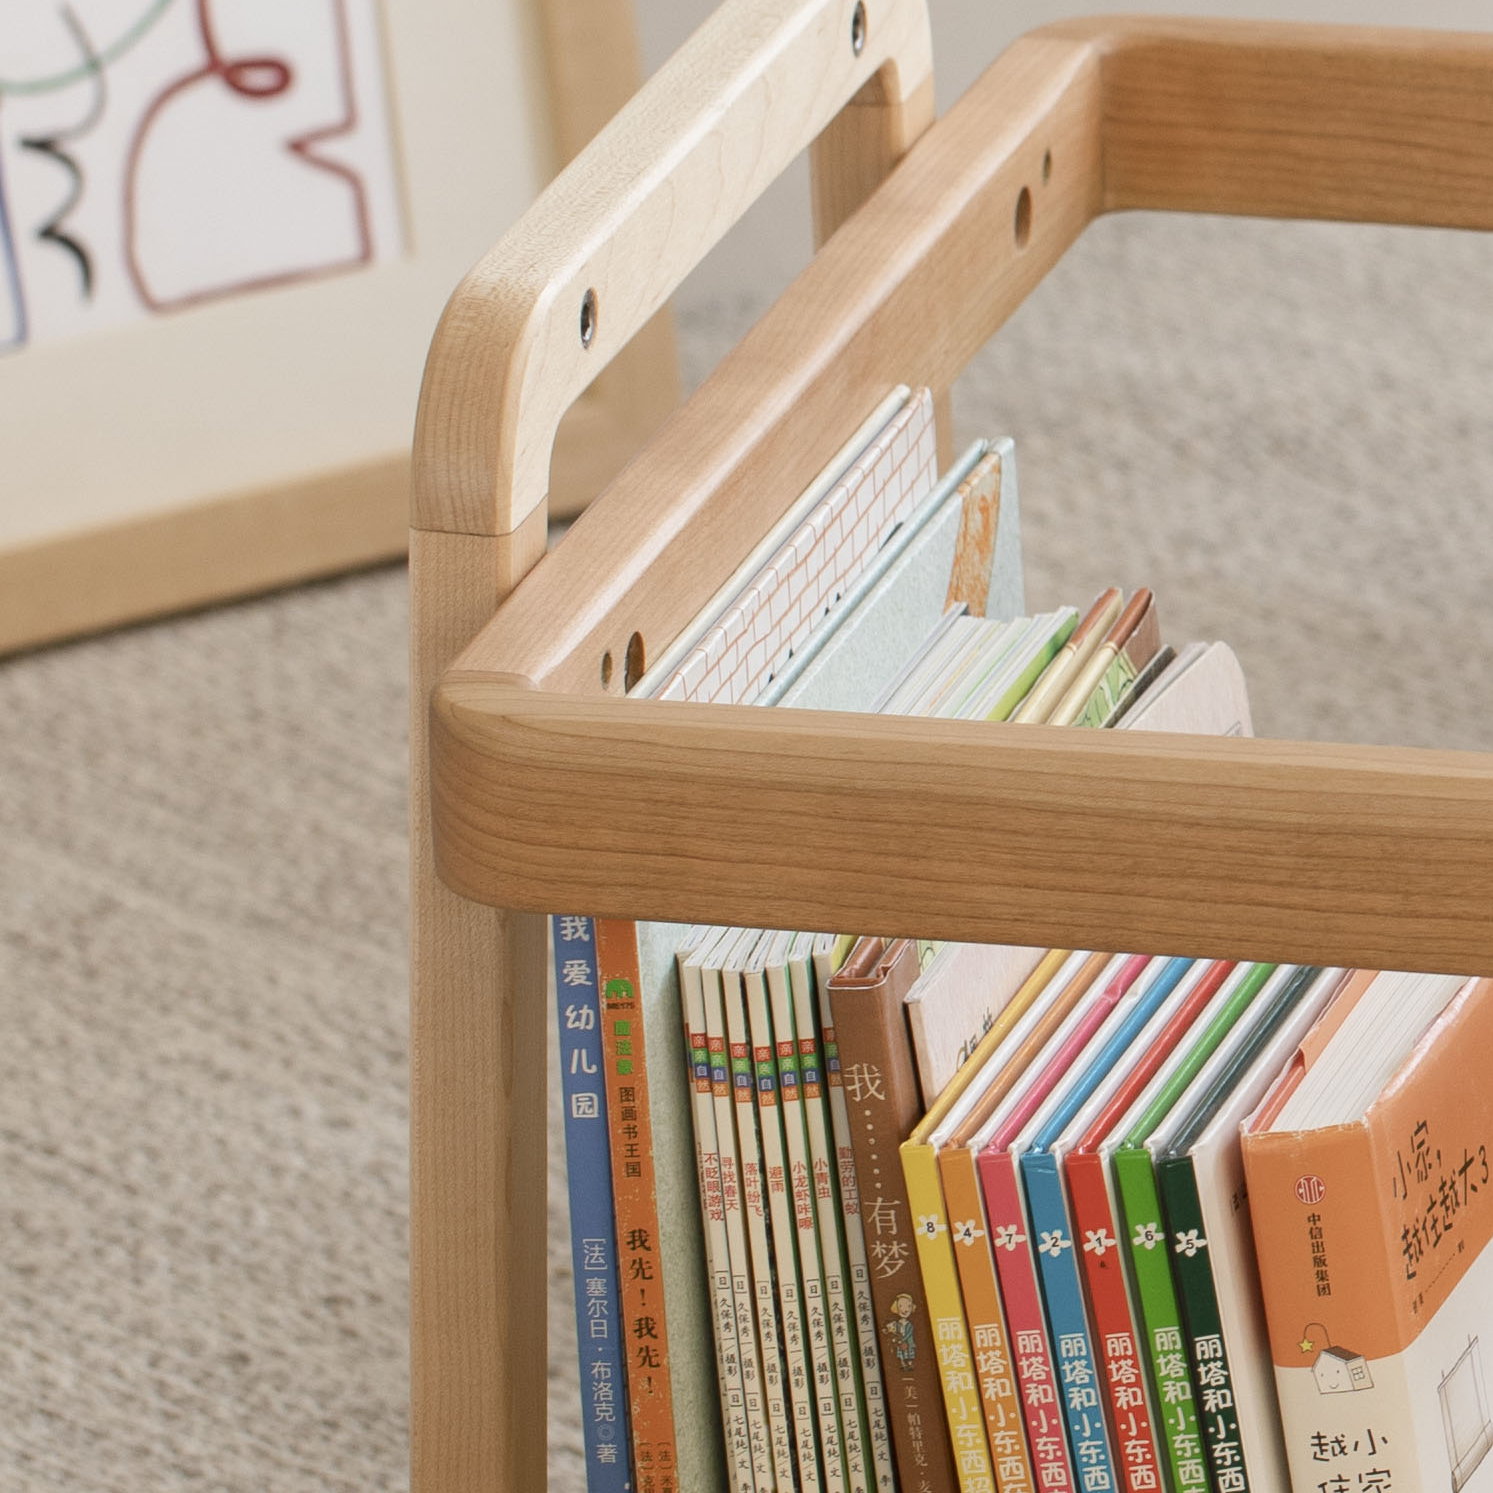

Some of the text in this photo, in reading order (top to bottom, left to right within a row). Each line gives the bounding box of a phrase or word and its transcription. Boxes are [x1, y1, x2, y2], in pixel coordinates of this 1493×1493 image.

[559, 916, 600, 1118] 我爱幼儿园
[690, 1033, 711, 1094] 亲亲自然
[708, 1037, 729, 1097] 亲亲自然
[731, 1043, 752, 1103] 亲亲自然
[754, 1046, 777, 1106] 亲亲自然
[777, 1041, 799, 1101] 亲亲自然
[798, 1039, 821, 1098] 亲亲自然
[618, 1086, 642, 1179] 图画书王国
[703, 1152, 724, 1221] 不眨眼游戏
[721, 1156, 739, 1211] 寻找春天
[744, 1162, 763, 1217] 落叶纷飞
[767, 1166, 785, 1193] 避雨
[814, 1157, 832, 1199] 小青虫
[838, 1146, 860, 1215] 勤劳的工蚁
[926, 1221, 936, 1233] 8
[962, 1226, 972, 1238] 4
[1004, 1231, 1014, 1243] 7
[1144, 1230, 1154, 1242] 6
[1401, 1144, 1490, 1280] 越住越大3
[1050, 1236, 1060, 1248] 2
[1095, 1236, 1103, 1248] 1
[1185, 1237, 1195, 1249] 5
[1306, 1212, 1331, 1298] 中信出版集团
[1105, 1331, 1158, 1491] 丽塔和小东西
